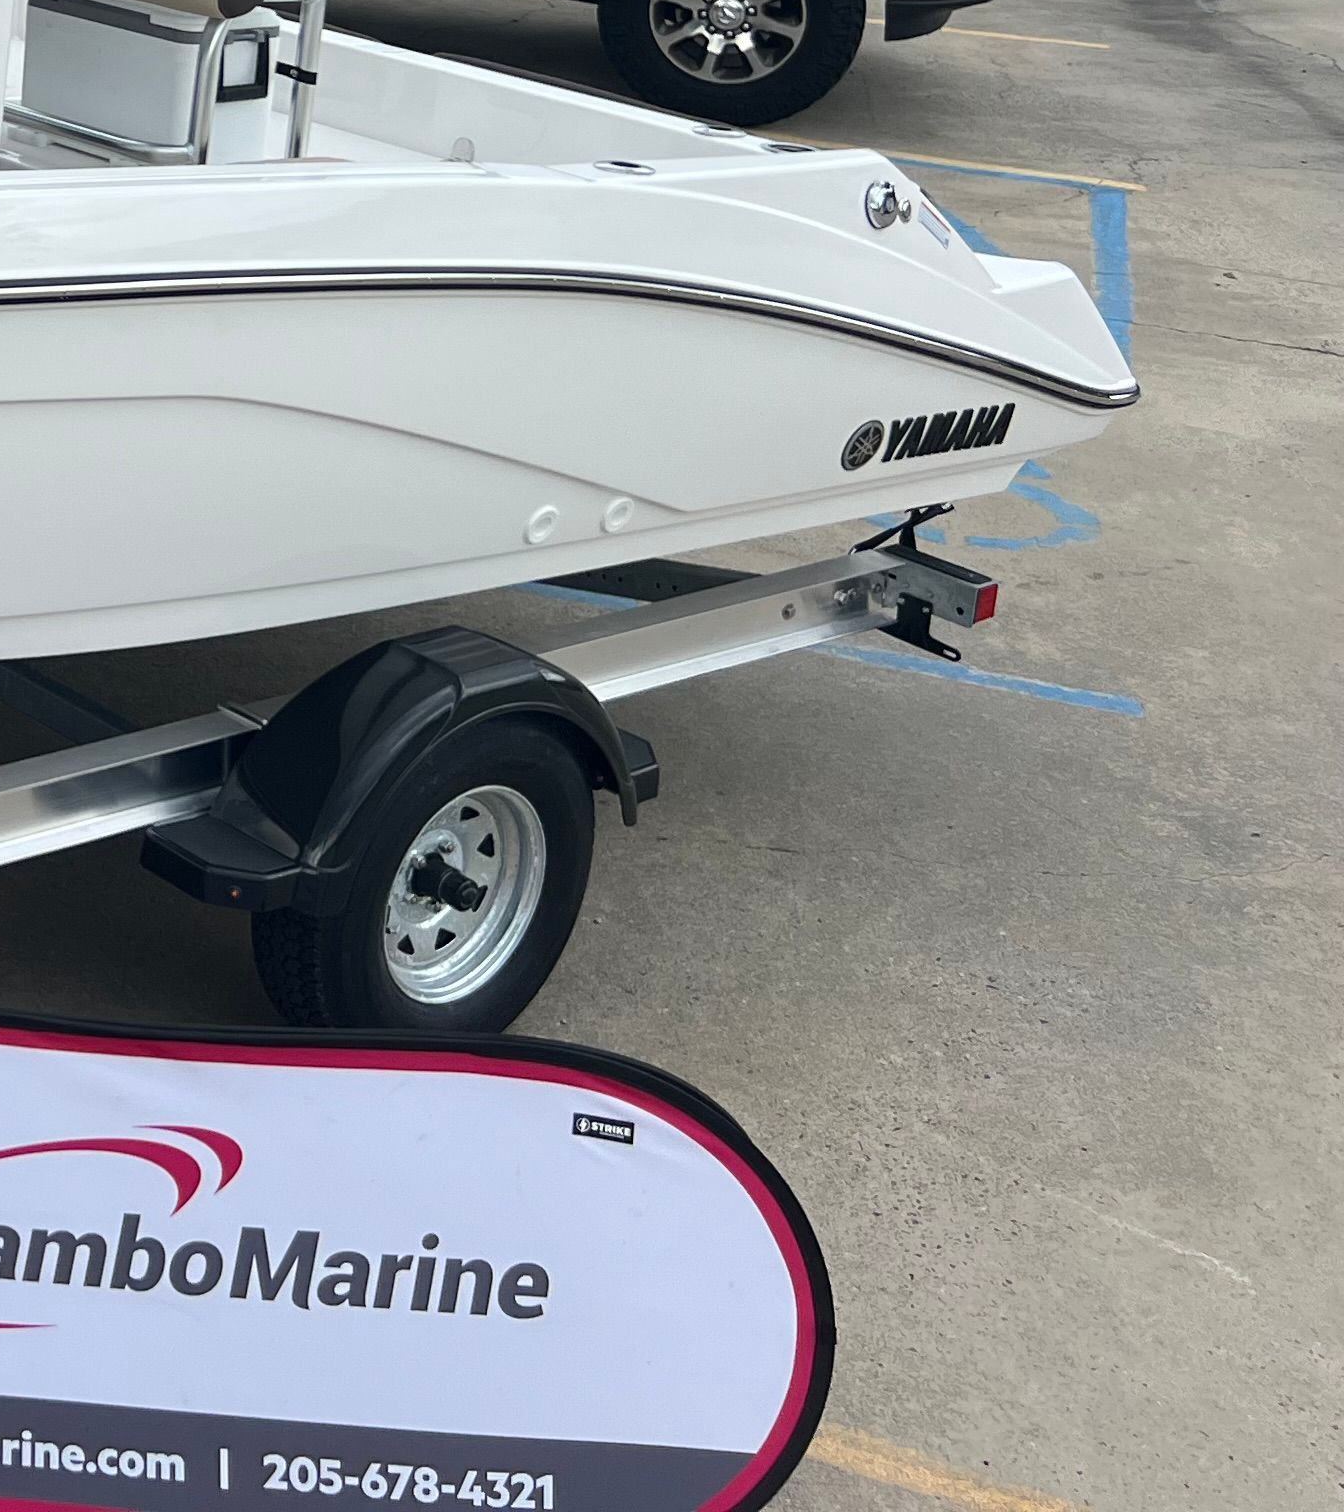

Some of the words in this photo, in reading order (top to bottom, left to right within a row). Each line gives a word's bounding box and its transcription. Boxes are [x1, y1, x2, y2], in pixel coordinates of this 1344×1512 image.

[880, 402, 1016, 463] YAMAHA
[591, 1121, 632, 1137] STRIKE
[261, 1453, 554, 1510] 205-678-4321
